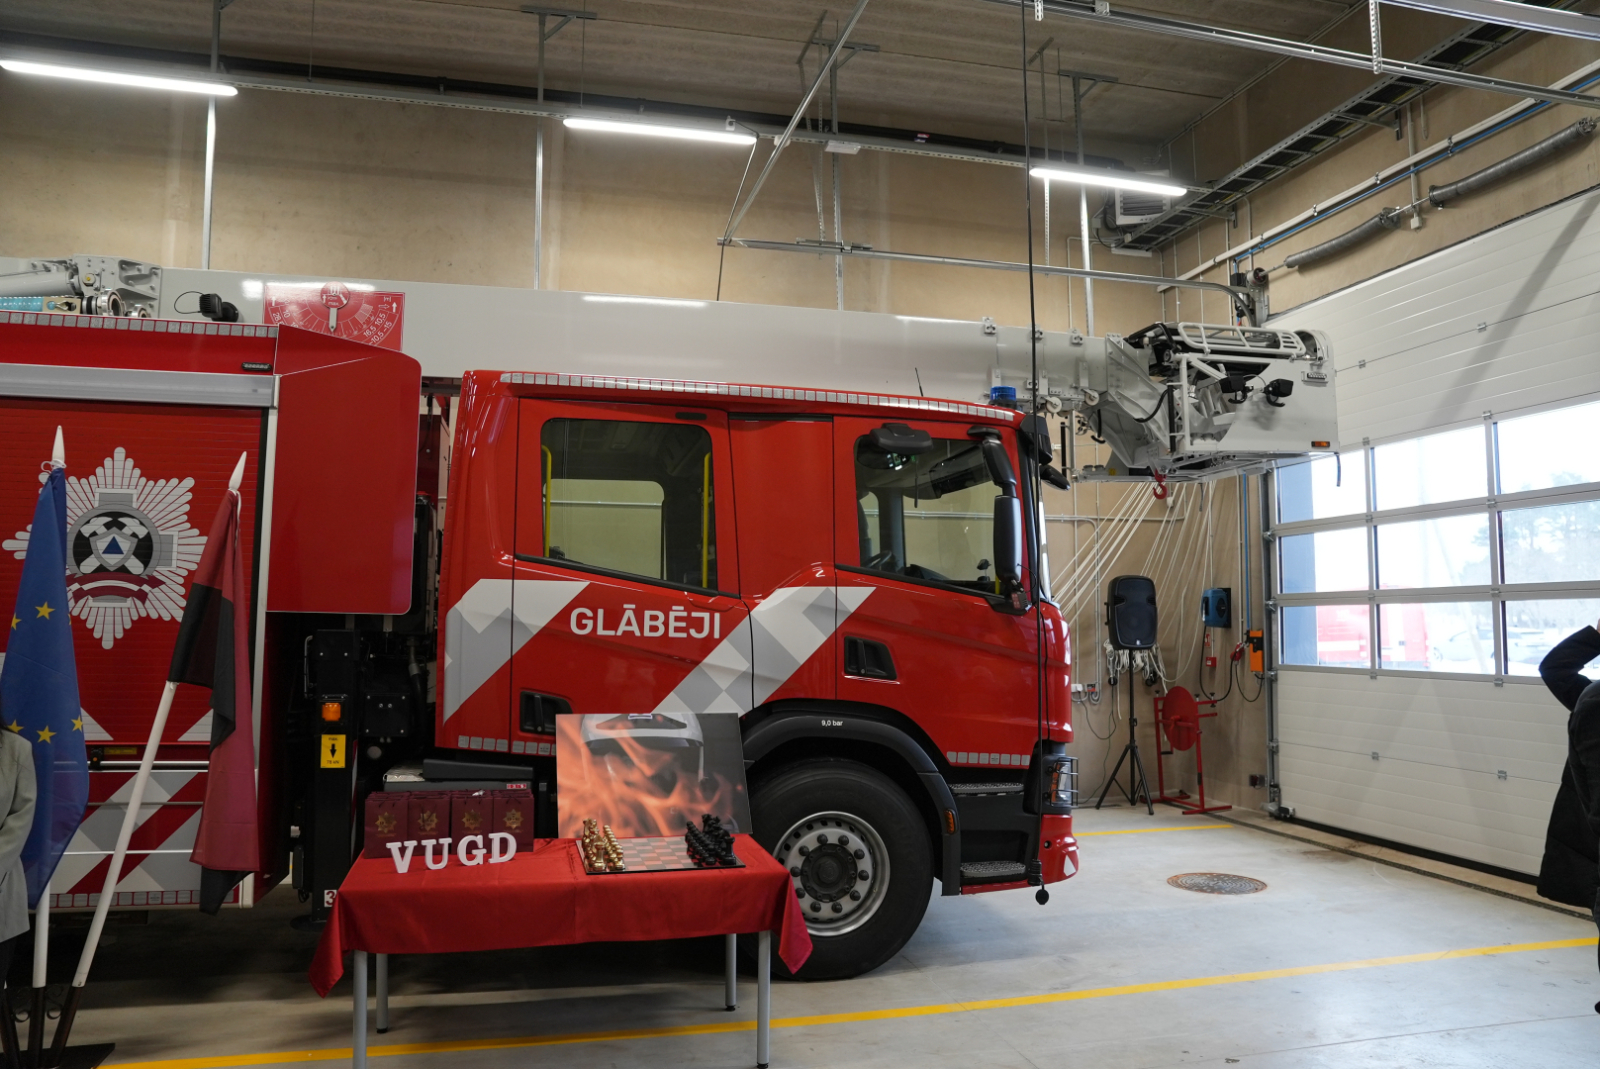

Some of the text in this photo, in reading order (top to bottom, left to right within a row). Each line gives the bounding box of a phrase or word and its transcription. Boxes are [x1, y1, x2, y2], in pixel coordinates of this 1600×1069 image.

[363, 312, 386, 338] 16,5 10,5
[383, 320, 393, 333] -15
[570, 604, 720, 639] GLĀBĒJI
[821, 719, 844, 727] 9,0 bar
[386, 832, 517, 873] VUGD
